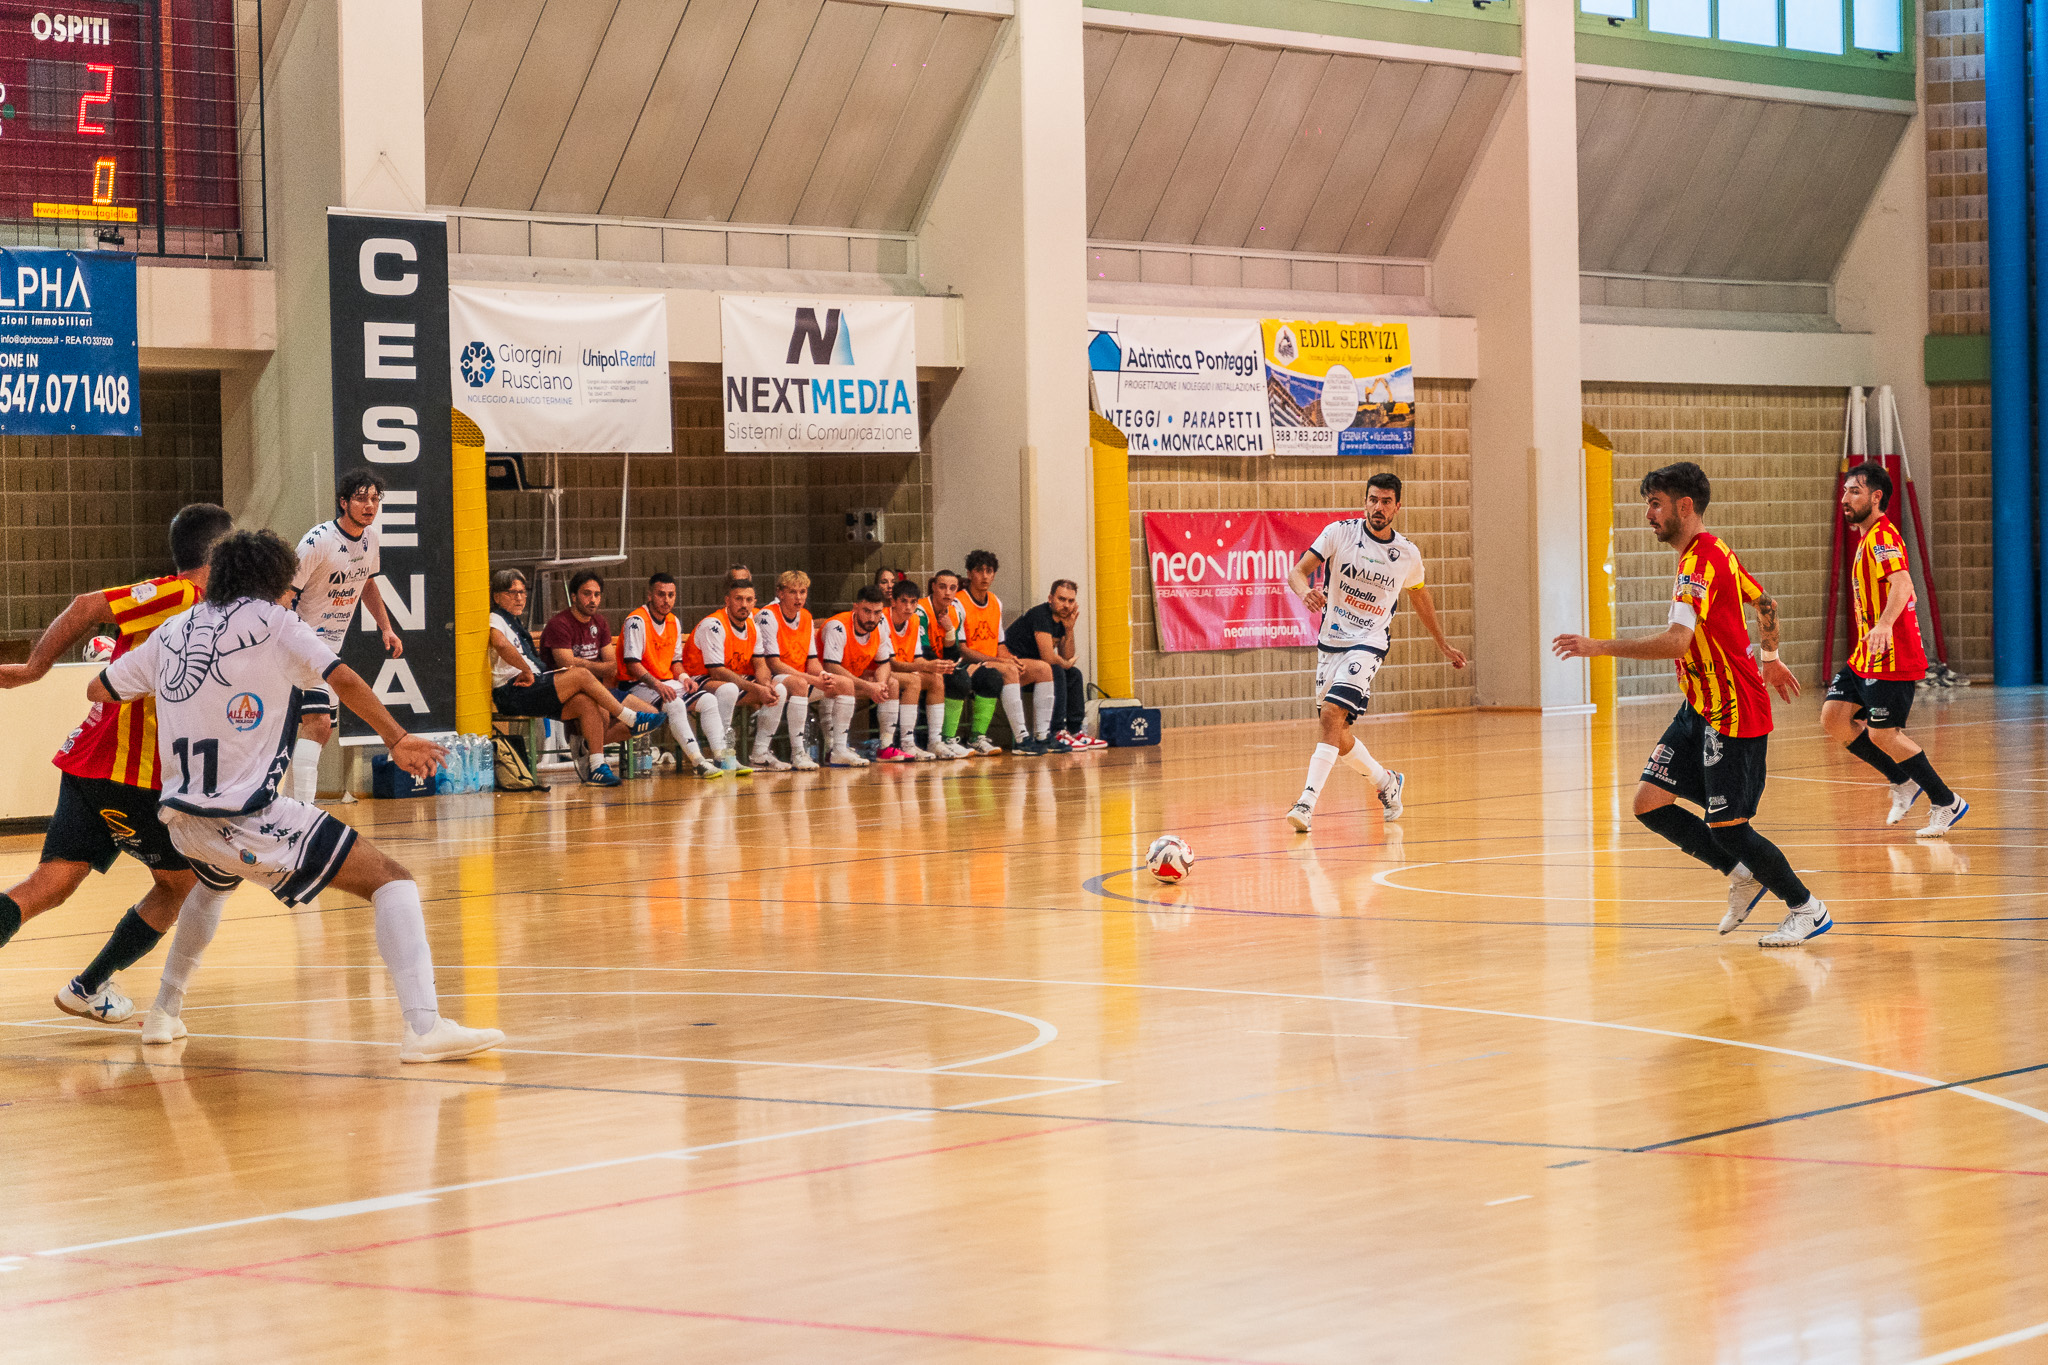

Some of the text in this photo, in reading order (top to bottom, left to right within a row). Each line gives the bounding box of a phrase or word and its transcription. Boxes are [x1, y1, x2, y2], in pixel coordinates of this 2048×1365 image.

[31, 12, 110, 46] OSPITI
[77, 63, 115, 135] 2
[92, 156, 117, 205] 0
[31, 315, 93, 327] immobiliari
[65, 336, 82, 345] REA
[83, 336, 92, 345] FO
[92, 336, 114, 346] 337500
[1300, 329, 1399, 350] EDIL SERVIZI
[0, 353, 39, 368] ONE IN
[498, 344, 562, 368] Giorgini
[582, 348, 656, 372] UnipolRental
[1127, 347, 1259, 376] Adriatica Ponteggi
[502, 370, 573, 391] Rusciano
[1124, 380, 1261, 392] PROGETTAZIONE NOLEGGIO INSTALLAZIONE
[0, 373, 130, 414] 547.071408
[467, 395, 573, 405] NOLEGGIO A LUNGO TERMINE
[726, 376, 912, 414] NEXTMEDIA
[1182, 411, 1261, 428] PARAPETTI
[728, 422, 913, 441] Sistemi di Comunicazione
[1161, 433, 1263, 451] MONTACARICHI
[358, 237, 430, 714] CESENA
[1357, 568, 1395, 588] ALPHA
[1215, 587, 1243, 597] DESIGN
[1245, 587, 1253, 596] &
[1339, 580, 1376, 603] Vitobello
[1344, 595, 1386, 616] Ricambi
[227, 710, 243, 719] ALL
[171, 737, 219, 795] 11
